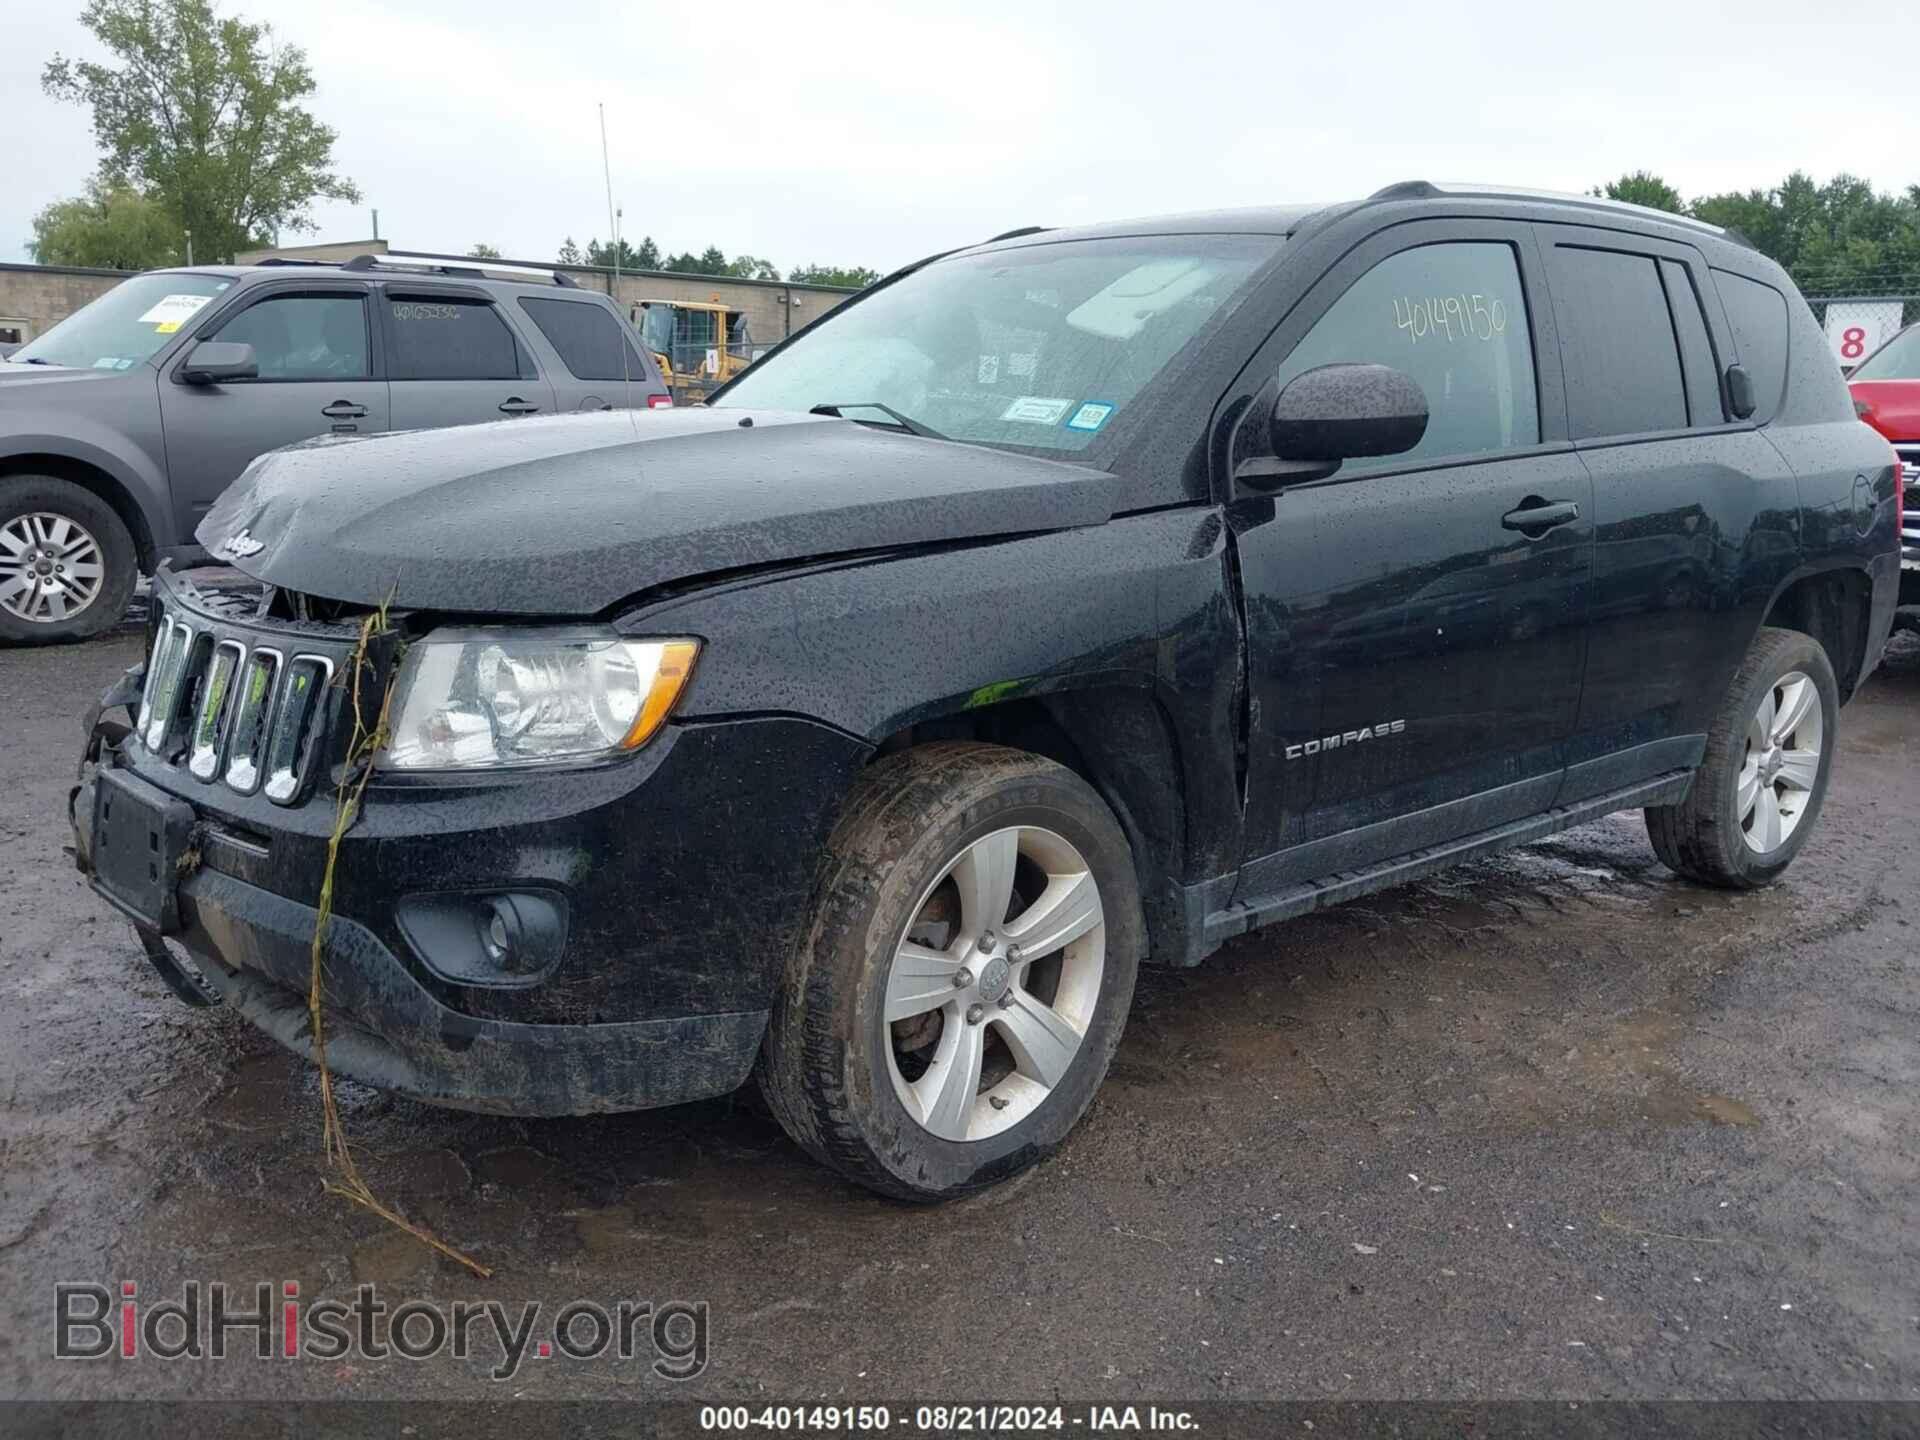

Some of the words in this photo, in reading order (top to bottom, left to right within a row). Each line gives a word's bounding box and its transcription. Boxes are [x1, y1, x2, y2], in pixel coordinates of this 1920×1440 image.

[1393, 293, 1506, 344] 40149150
[1841, 327, 1865, 358] 8
[1285, 719, 1405, 760] COMPASS
